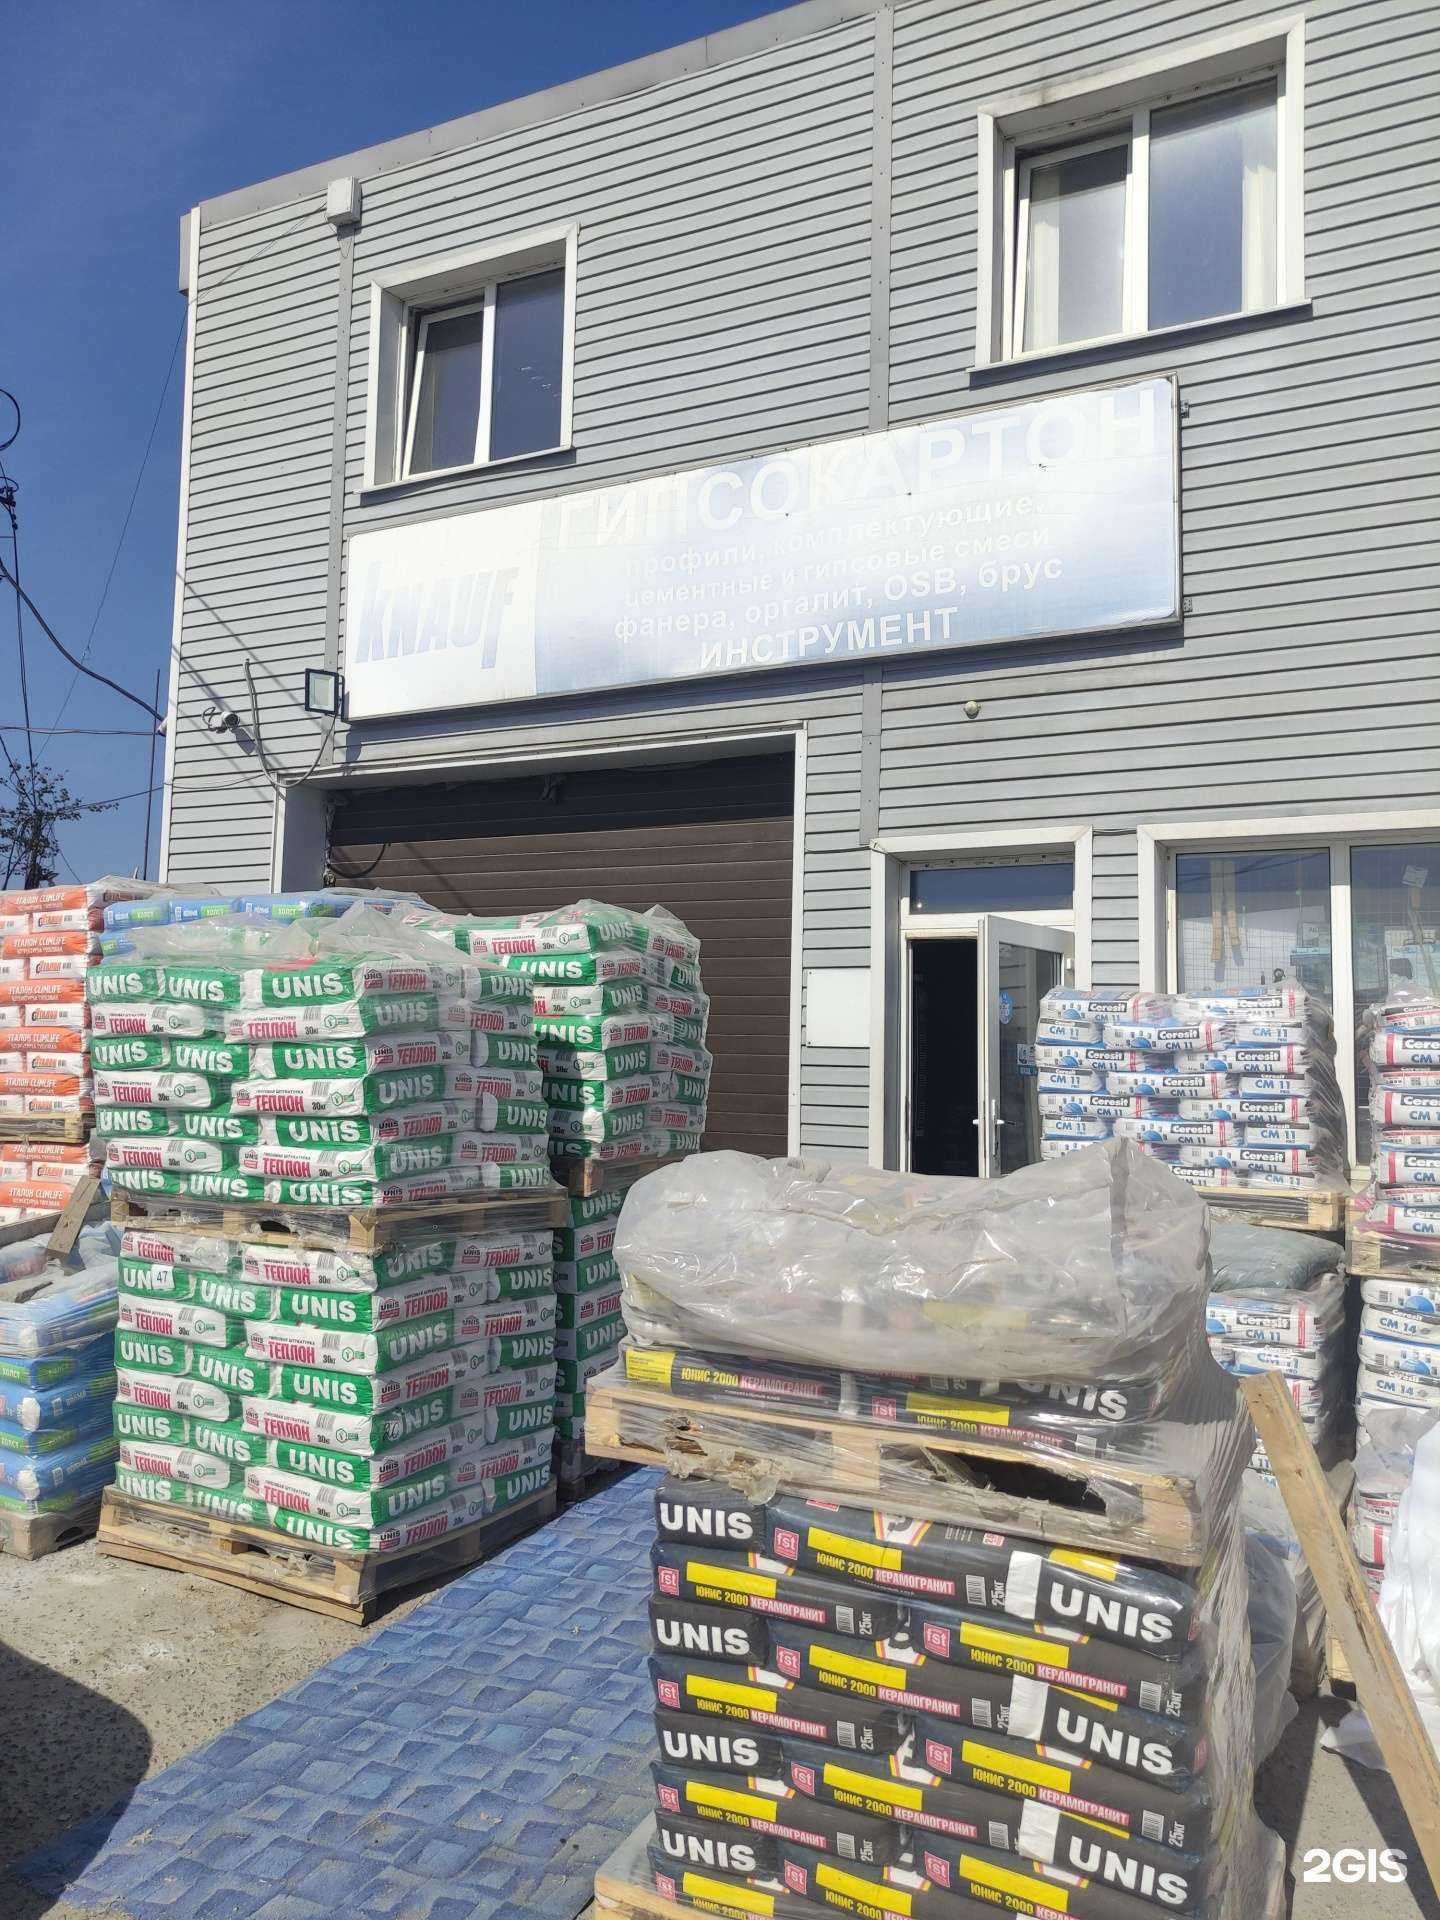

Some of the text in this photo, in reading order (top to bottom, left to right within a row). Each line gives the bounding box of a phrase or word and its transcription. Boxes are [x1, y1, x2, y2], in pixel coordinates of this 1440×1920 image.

[558, 389, 1155, 549] ГИПСОКАРТОН
[625, 573, 773, 609] цементные
[803, 543, 945, 581] гипсовые
[955, 528, 1050, 557] смеси
[626, 543, 766, 577] профили,
[614, 557, 1064, 642] фанера, оргалит, OSB, брус
[355, 560, 520, 669] KNAUF
[700, 607, 959, 668] ИНСТРУМЕНТ
[89, 973, 143, 996] UNIS
[169, 976, 225, 1001] UNIS
[272, 973, 344, 999] UNIS
[1089, 1003, 1126, 1012] Ceresit
[109, 1017, 147, 1034] ТЕПЛОН
[247, 1021, 297, 1039] ТЕПЛОН
[1158, 1030, 1198, 1039] Ceresit
[95, 1041, 148, 1065] UNIS
[176, 1046, 233, 1072] UNIS
[284, 1046, 357, 1069] UNIS
[1087, 1050, 1123, 1060] Ceresit
[1237, 1052, 1279, 1061] Ceresit
[1411, 1054, 1432, 1063] CM
[379, 1075, 434, 1103] UNIS
[1163, 1077, 1204, 1087] Ceresit
[1170, 1089, 1198, 1097] CM 11
[1255, 1079, 1290, 1089] CM 11
[112, 1085, 152, 1103] ТЕПЛОН
[255, 1095, 305, 1113] ТЕПЛОН
[1091, 1097, 1130, 1106] Ceresit
[508, 1106, 546, 1129] UNIS
[1096, 1108, 1112, 1116] CM
[1241, 1103, 1284, 1113] Ceresit
[1409, 1111, 1430, 1120] CM
[100, 1109, 153, 1131] UNIS
[185, 1115, 244, 1138] UNIS
[288, 1120, 360, 1142] UNIS
[1171, 1124, 1212, 1134] Ceresit
[1178, 1136, 1206, 1144] CM 11
[122, 1151, 163, 1168] ТЕПЛОН
[262, 1157, 311, 1178] ТЕПЛОН
[1241, 1151, 1284, 1161] Ceresit
[1173, 1166, 1214, 1177] Ceresit
[1414, 1172, 1436, 1182] CM
[190, 1175, 249, 1198] UNIS
[289, 1182, 363, 1206] UNIS
[1412, 1222, 1434, 1233] CM
[156, 1270, 168, 1282] 47
[262, 1263, 311, 1285] ТЕПЛОН
[202, 1279, 256, 1311] UNIS
[291, 1296, 356, 1323] UNIS
[135, 1313, 173, 1335] ТЕПЛОН
[1379, 1318, 1417, 1333] CM 14
[121, 1341, 174, 1365] UNIS
[267, 1340, 315, 1364] ТЕПЛОН
[389, 1325, 447, 1361] UNIS
[200, 1355, 254, 1391] UNIS
[681, 1367, 711, 1381] ЮНИС
[713, 1371, 739, 1386] 2000
[133, 1387, 171, 1410] ТЕПЛОН
[294, 1374, 358, 1404] UNIS
[1377, 1379, 1414, 1396] CM 14
[118, 1414, 171, 1438] UNIS
[509, 1405, 552, 1431] UNIS
[264, 1418, 310, 1442] ТЕПЛОН
[195, 1427, 250, 1462] UNIS
[134, 1456, 172, 1478] ТЕПЛОН
[289, 1449, 354, 1483] UNIS
[120, 1475, 171, 1500] UNIS
[507, 1466, 549, 1500] UNIS
[263, 1487, 310, 1513] ТЕПЛОН
[389, 1475, 444, 1516] UNIS
[659, 1502, 753, 1540] UNIS
[776, 1530, 796, 1549] fst
[659, 1570, 678, 1586] fst
[816, 1552, 846, 1571] ЮНИС
[847, 1561, 874, 1580] 2000
[875, 1568, 955, 1595] КЕРАМОГРАНИТ
[696, 1585, 826, 1623] ЮНИС 2000 КЕРАМОГРАНИТ
[1050, 1582, 1173, 1643] UNIS
[656, 1618, 750, 1655] UNIS
[925, 1627, 948, 1648] fst
[777, 1650, 799, 1669] fst
[970, 1648, 1127, 1697] ЮНИС 2000 КЕРАМОГРАНИТ
[659, 1683, 678, 1700] fst
[818, 1670, 960, 1716] ЮНИС 2000 КЕРАМОГРАНИТ
[697, 1698, 826, 1737] ЮНИС 2000 КЕРАМОГРАНИТ
[662, 1730, 759, 1766] UNIS
[926, 1743, 949, 1763] fst
[1056, 1707, 1174, 1776] UNIS
[972, 1767, 1129, 1826] ЮНИС 2000 КЕРАМОГРАНИТ
[833, 1789, 977, 1837] ЮНИС 2000 КЕРАМОГРАНИТ
[696, 1805, 826, 1847] ЮНИС 2000 КЕРАМОГРАНИТ
[661, 1829, 757, 1871] UNIS
[1068, 1836, 1189, 1905] UNIS
[825, 1890, 853, 1910] ЮНИС
[856, 1901, 882, 1920] 2000
[970, 1883, 1002, 1904] ЮНИС
[1005, 1894, 1034, 1914] 2000
